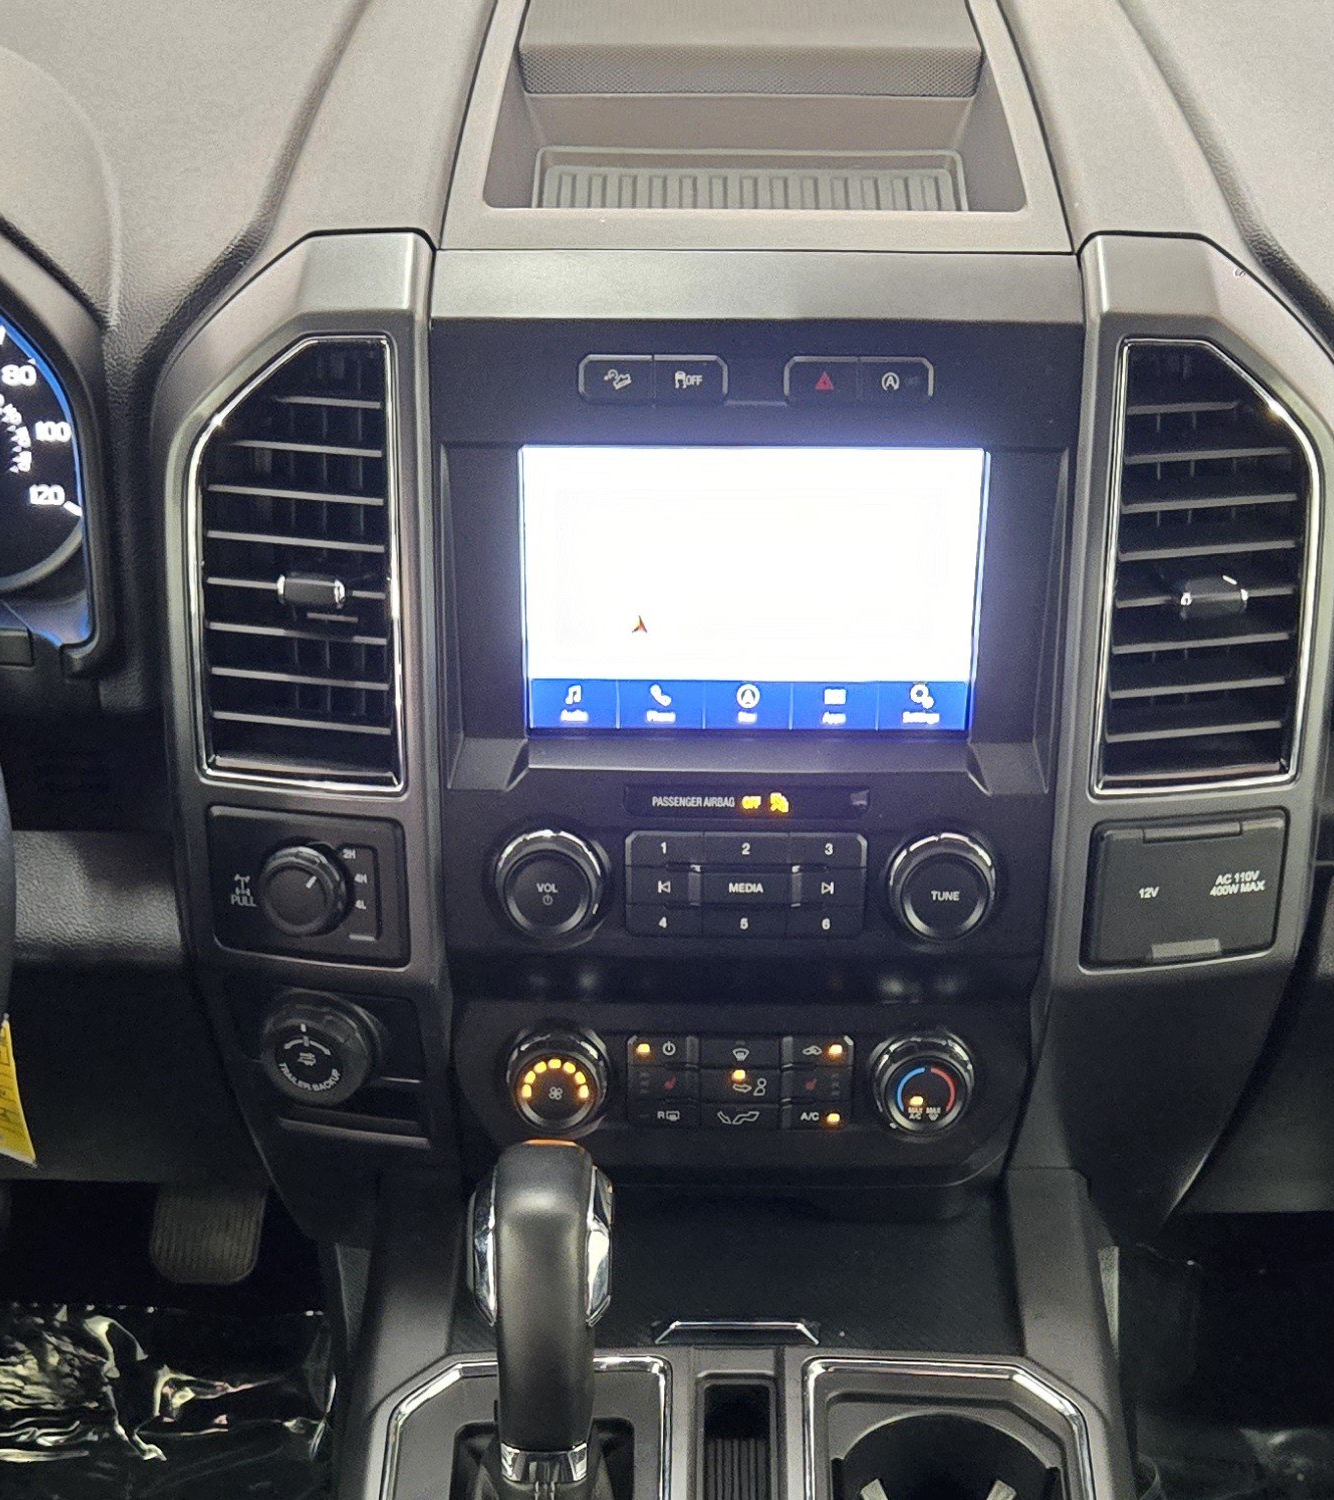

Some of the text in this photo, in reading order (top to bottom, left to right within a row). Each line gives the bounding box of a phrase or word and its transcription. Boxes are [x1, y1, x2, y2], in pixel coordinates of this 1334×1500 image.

[1, 364, 37, 387] 80
[686, 374, 703, 386] OFF
[35, 421, 72, 442] 100
[29, 484, 65, 506] 120
[652, 796, 702, 808] PASSENGER
[703, 796, 735, 808] AIRBAG
[660, 843, 667, 854] 1
[742, 843, 750, 855] 2
[825, 843, 833, 855] 3
[1215, 871, 1260, 885] AC 110V
[536, 882, 558, 894] VOL
[728, 882, 763, 894] MEDIA
[1139, 886, 1160, 899] 12V
[1210, 880, 1266, 897] 400W MAX
[230, 894, 257, 907] PULL
[931, 890, 960, 901] TUNE
[659, 918, 667, 929] 4
[740, 918, 748, 930] 5
[822, 918, 830, 930] 6
[801, 1111, 820, 1121] A/C
